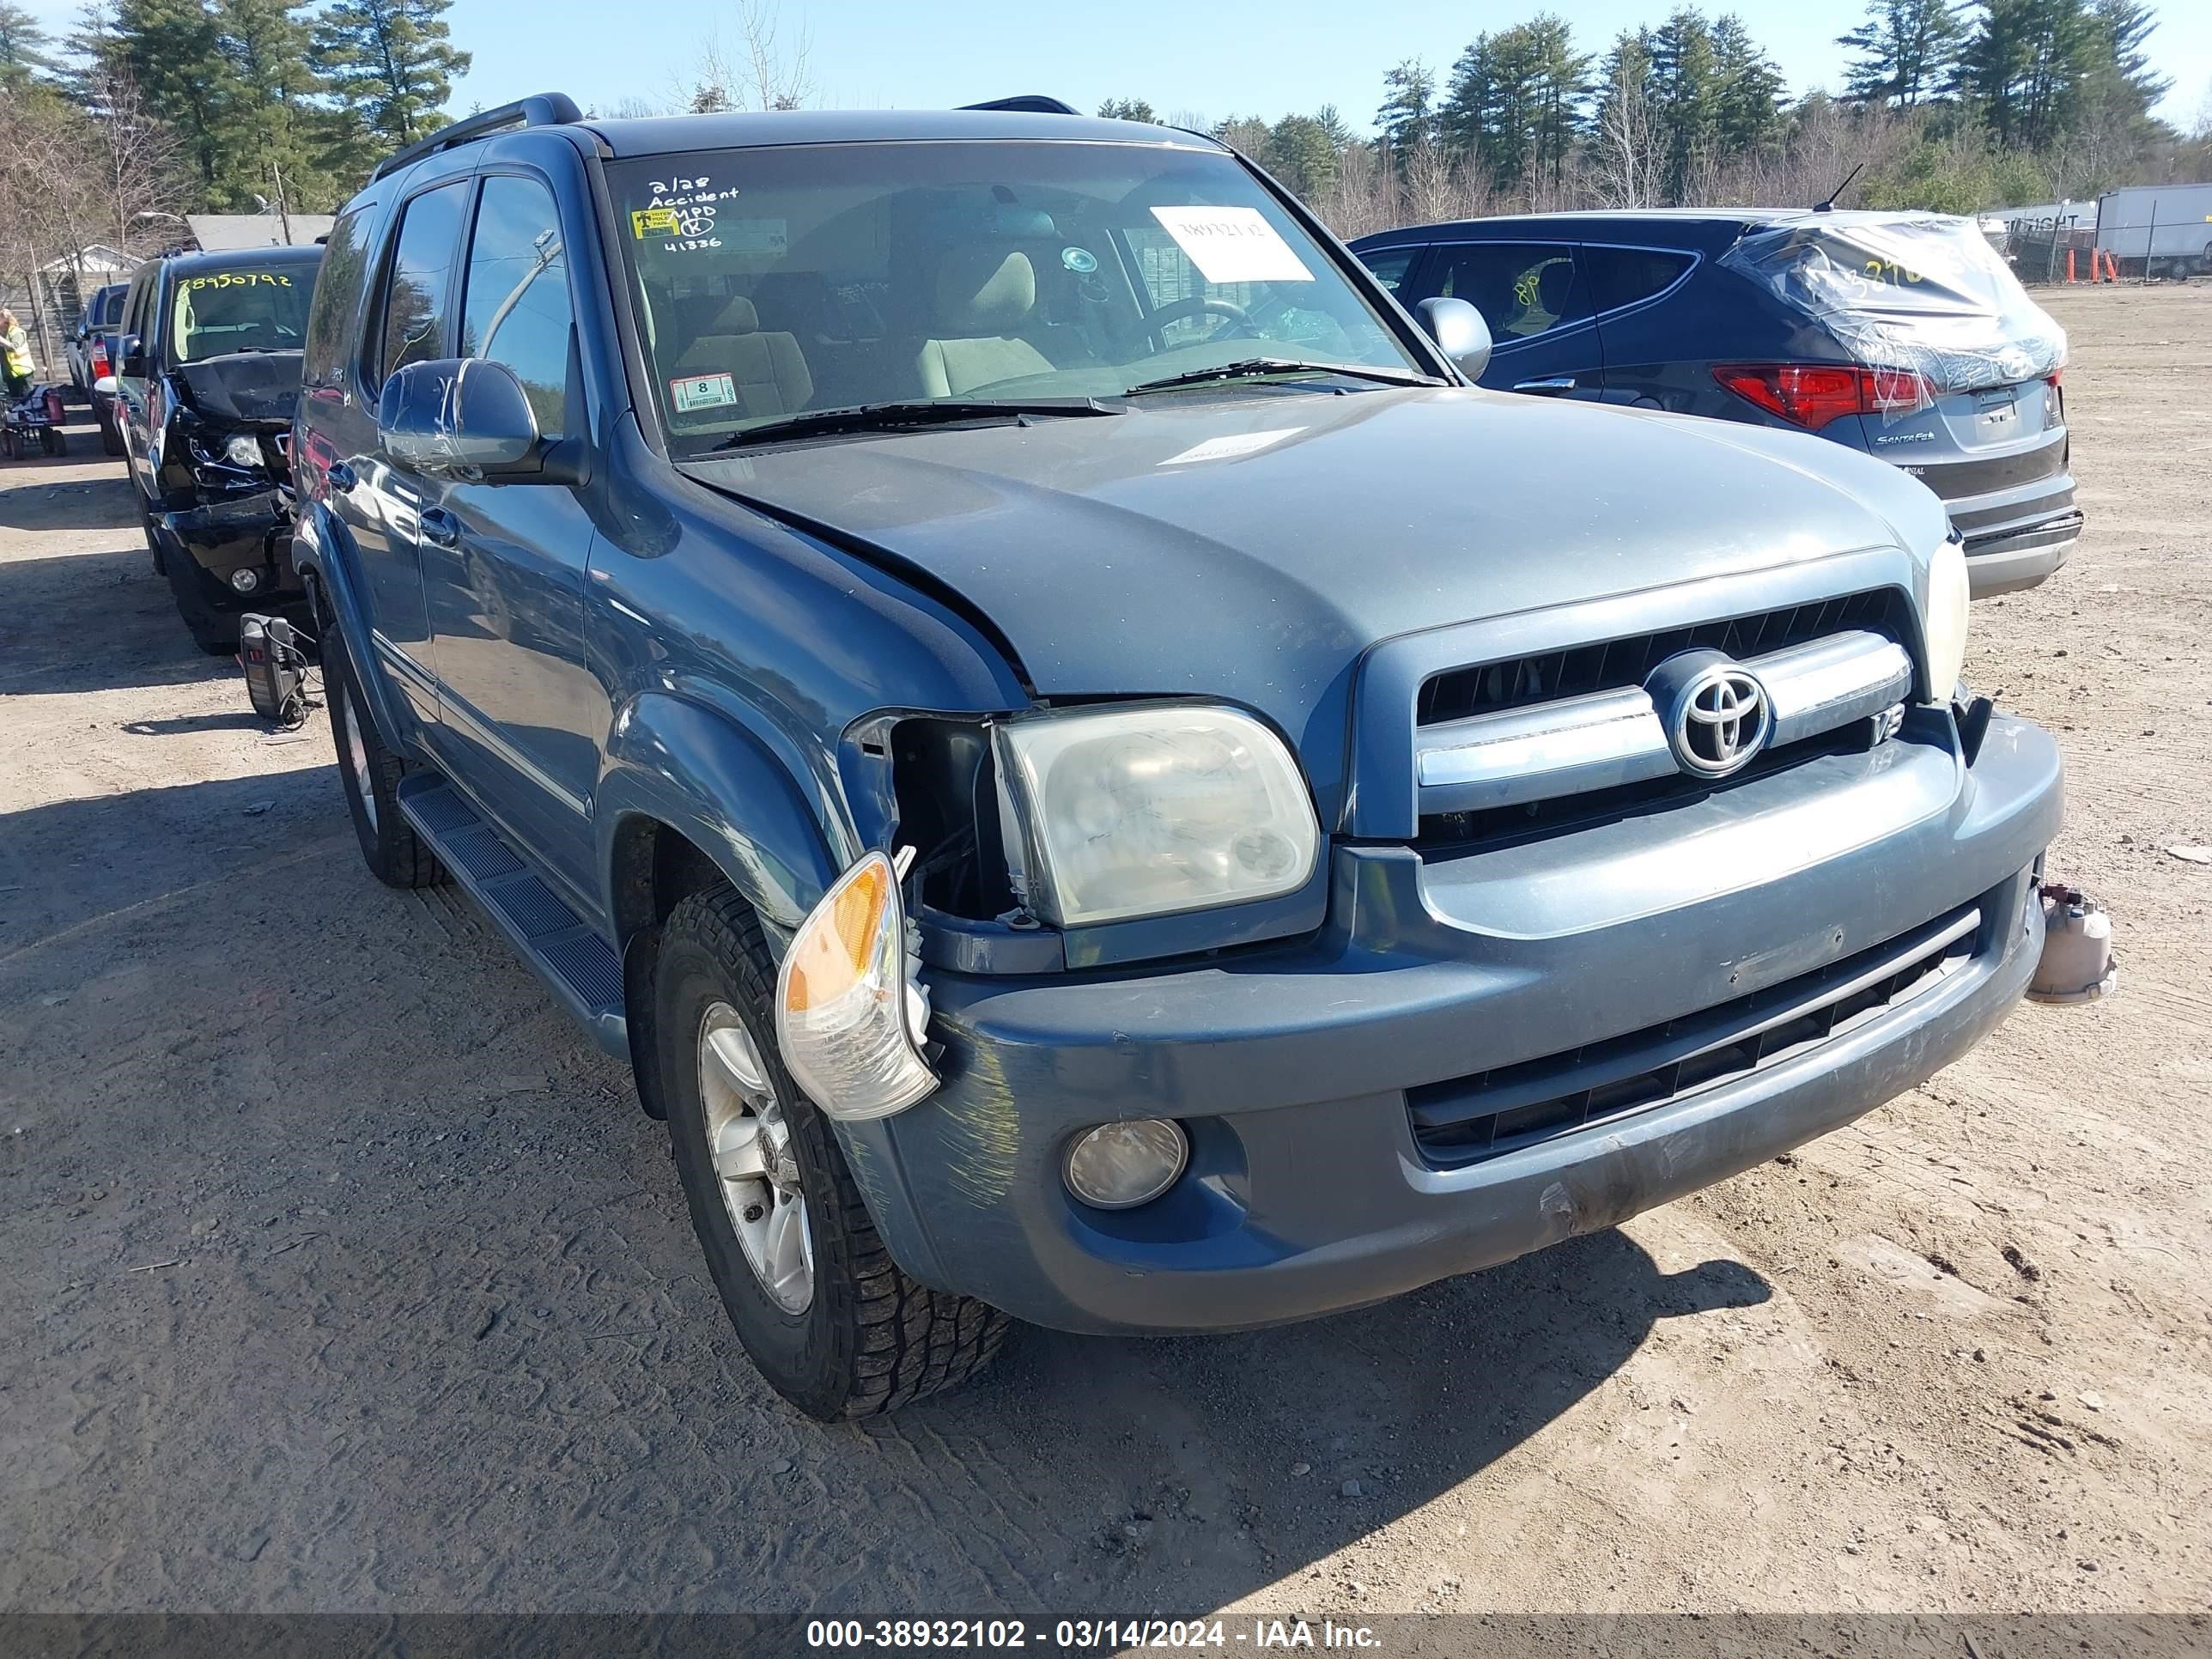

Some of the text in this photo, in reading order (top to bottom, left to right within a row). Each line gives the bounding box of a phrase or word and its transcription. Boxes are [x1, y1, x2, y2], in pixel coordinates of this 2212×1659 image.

[648, 176, 710, 194] 2/28
[647, 187, 739, 210] Accident
[667, 206, 717, 222] MPD
[664, 237, 722, 252] 41336
[698, 382, 709, 393] 8
[1870, 702, 1905, 745] V8
